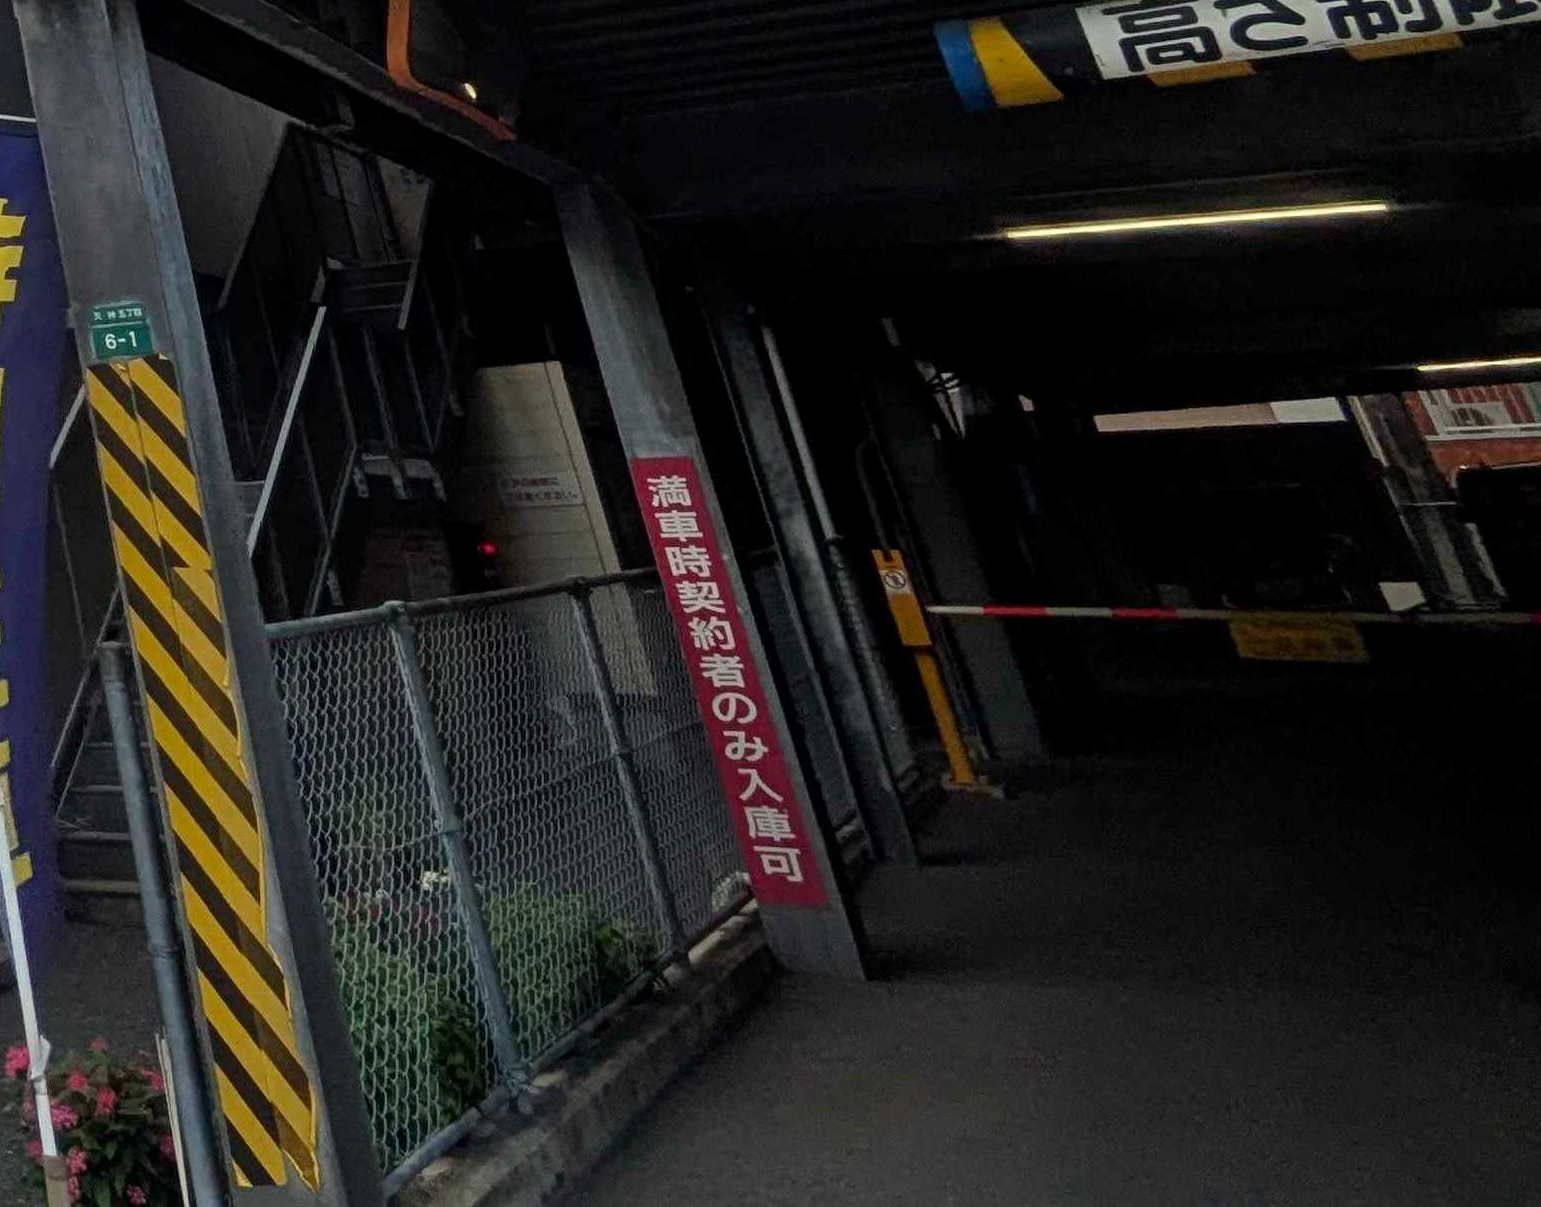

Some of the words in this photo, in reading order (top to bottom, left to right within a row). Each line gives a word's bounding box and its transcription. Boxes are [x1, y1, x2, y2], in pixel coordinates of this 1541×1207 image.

[105, 330, 138, 350] 6-1
[646, 472, 805, 884] 満車時契約者のみ入庫可
